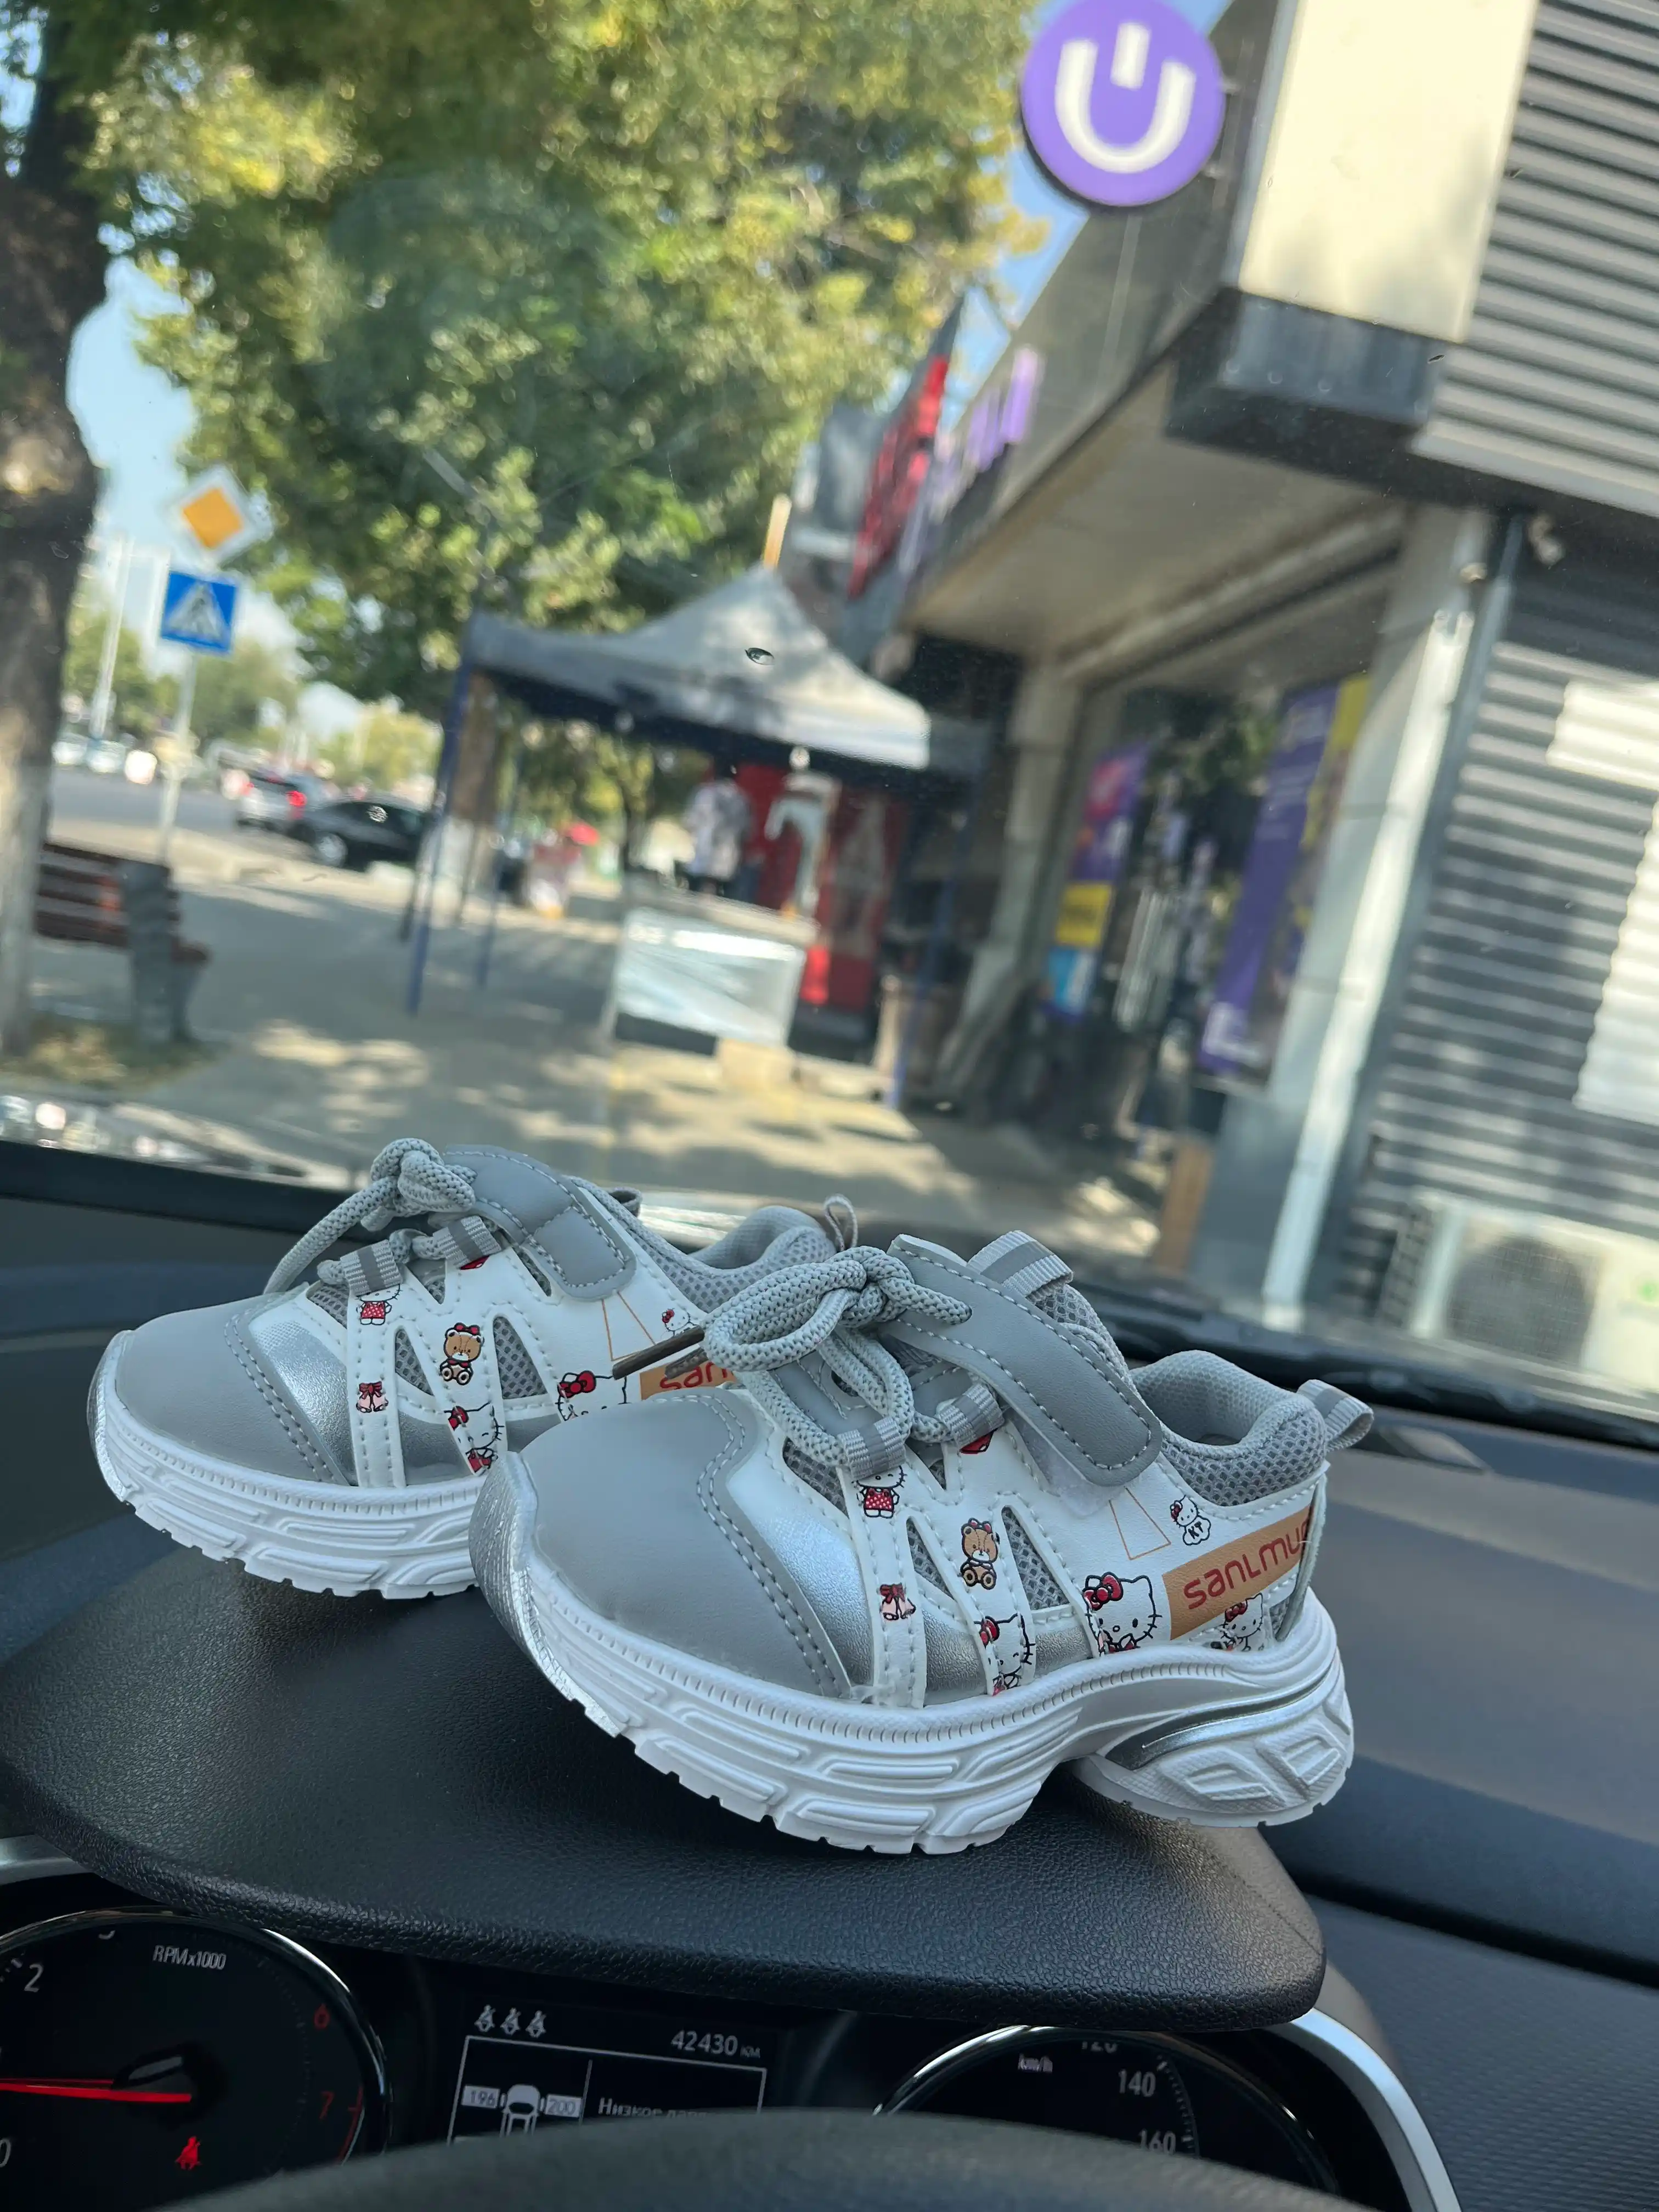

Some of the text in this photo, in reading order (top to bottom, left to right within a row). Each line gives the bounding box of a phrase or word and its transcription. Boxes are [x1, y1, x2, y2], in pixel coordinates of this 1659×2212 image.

[1188, 1521, 1204, 1539] KT
[152, 1944, 227, 1971] RPMx1000
[23, 1963, 44, 1993] 2
[313, 2003, 330, 2030] 6
[670, 2029, 738, 2056] 42430
[1118, 2068, 1156, 2097] 140
[319, 2090, 335, 2120] 7
[470, 2089, 496, 2107] 196
[548, 2098, 576, 2116] 200
[1138, 2129, 1176, 2155] 160
